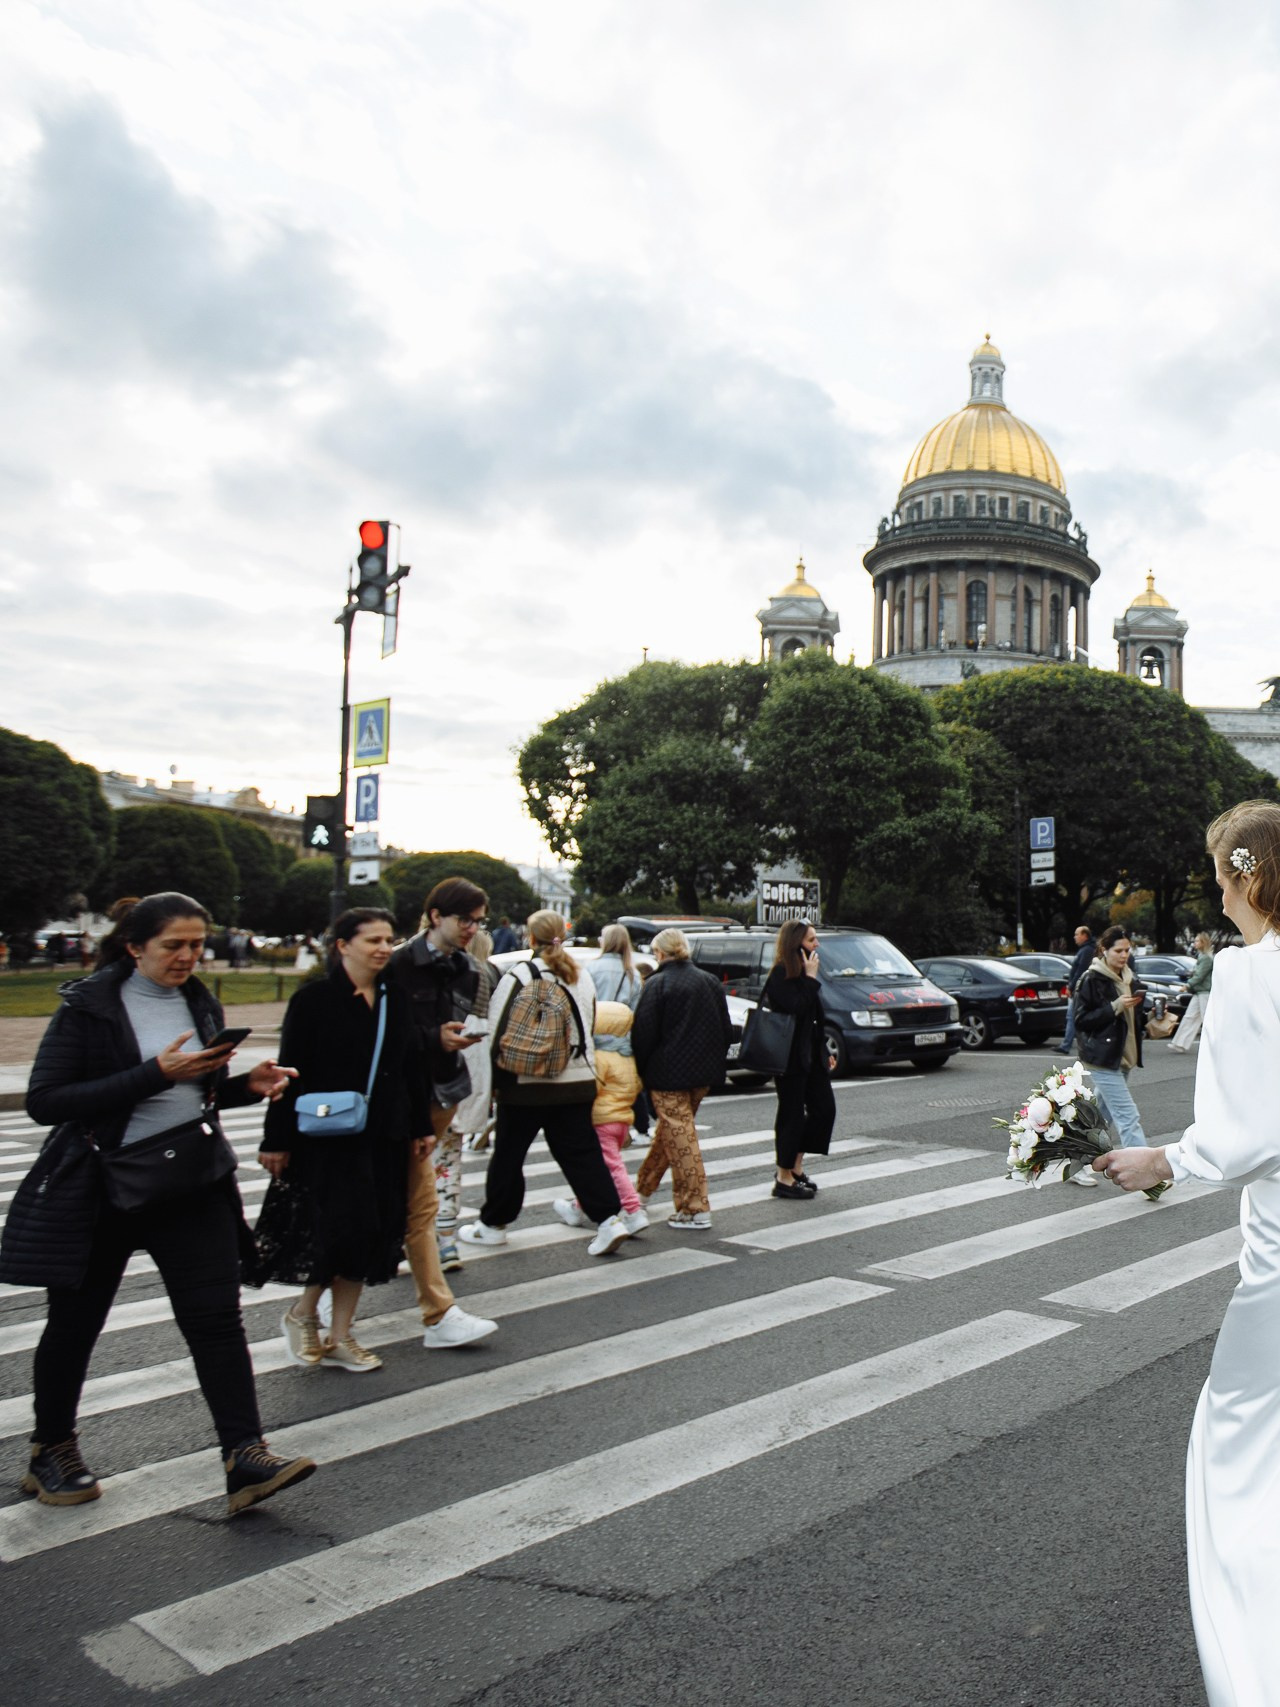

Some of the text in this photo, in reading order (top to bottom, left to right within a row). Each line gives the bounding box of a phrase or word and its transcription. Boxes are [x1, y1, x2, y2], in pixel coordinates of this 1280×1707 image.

[359, 778, 377, 818] P
[1037, 821, 1050, 845] P
[762, 882, 805, 904] Coffee
